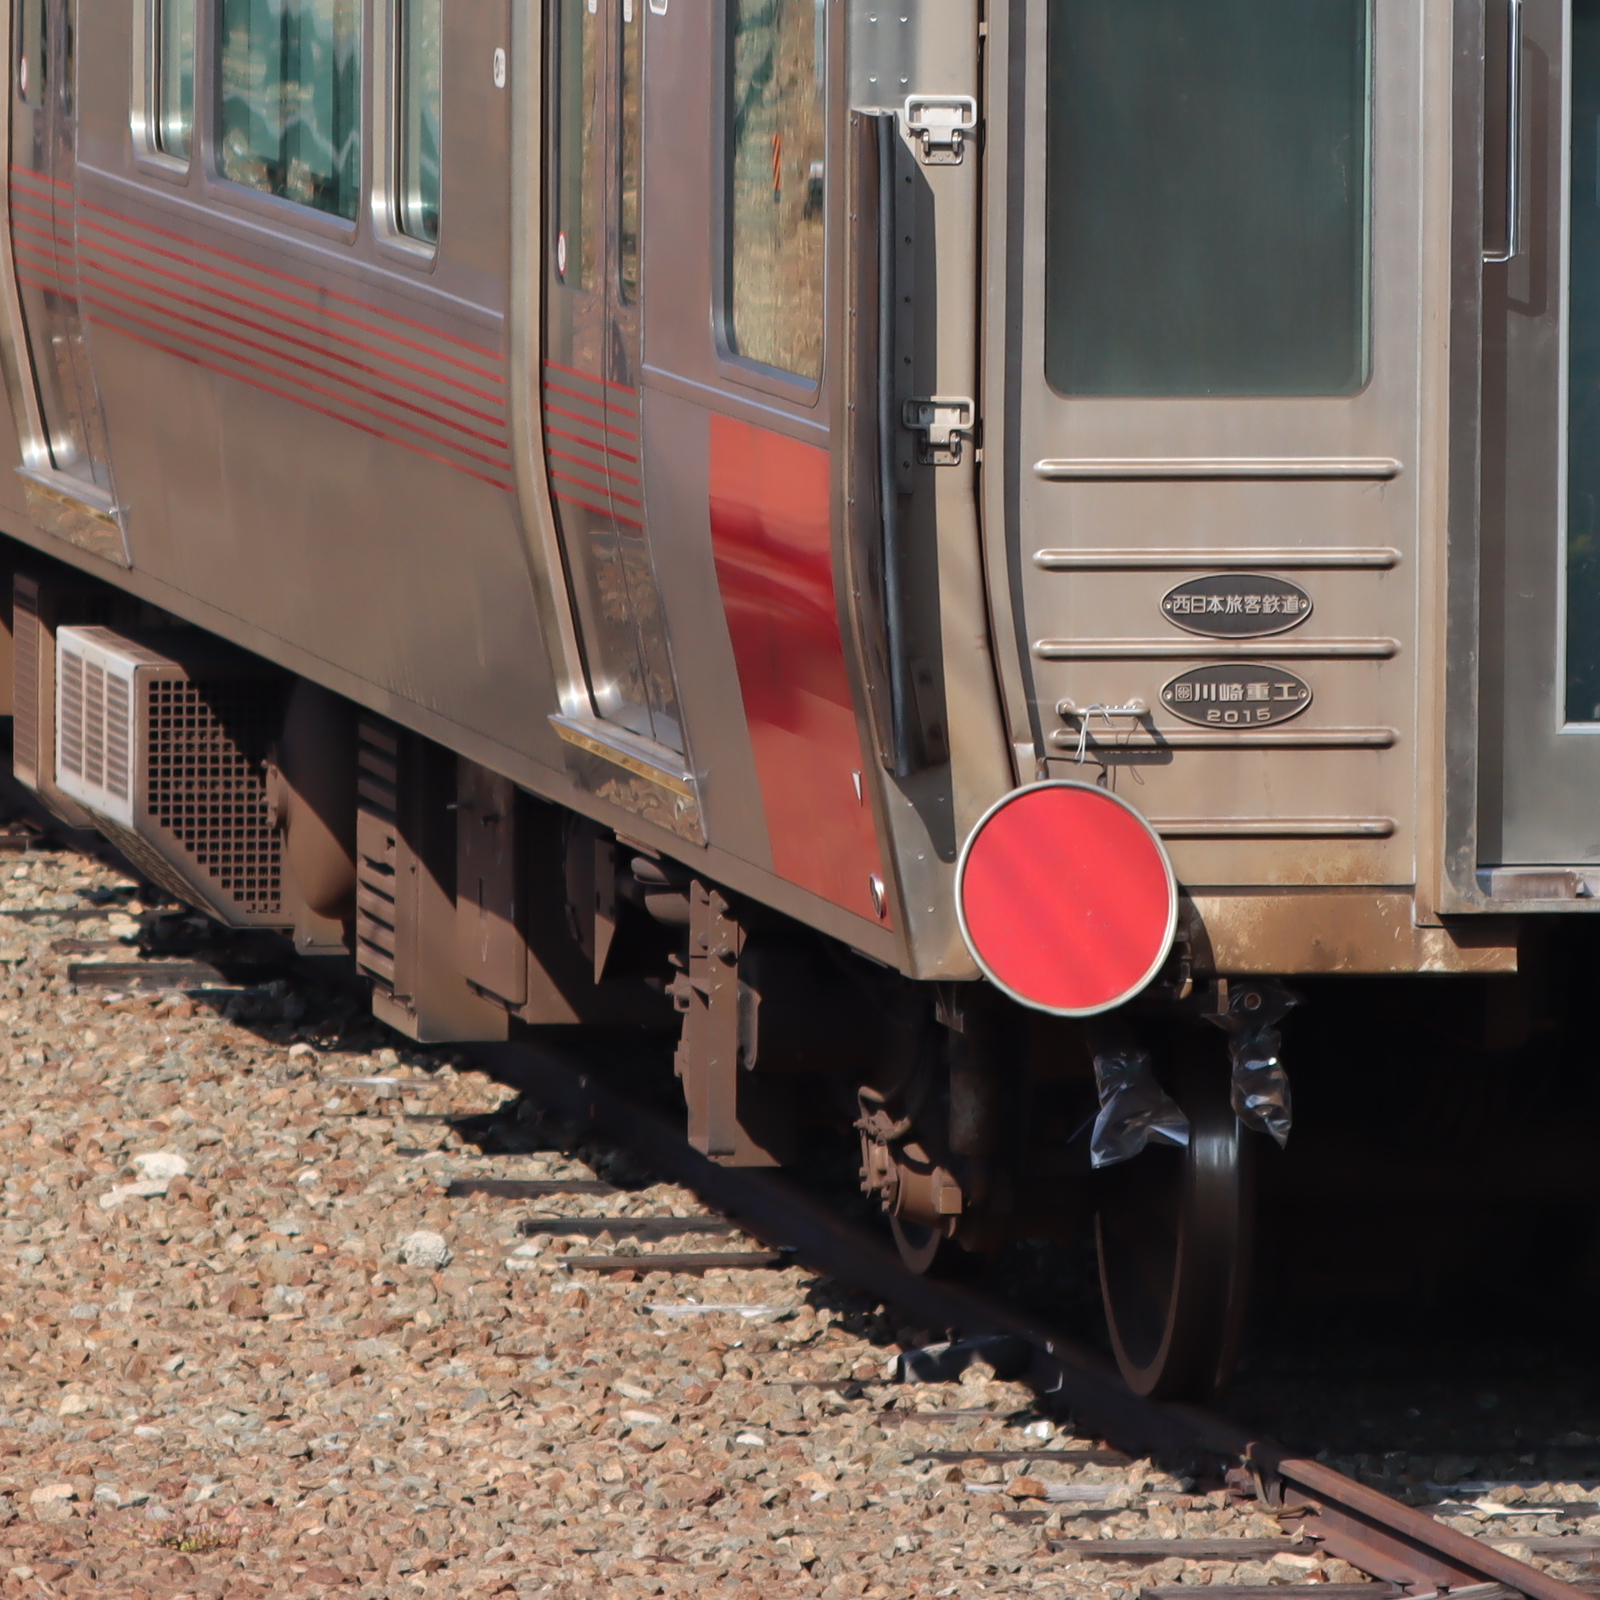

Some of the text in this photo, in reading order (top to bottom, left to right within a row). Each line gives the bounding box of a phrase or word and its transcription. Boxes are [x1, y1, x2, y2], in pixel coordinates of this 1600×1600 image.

[1193, 682, 1299, 702] 川崎重工
[1206, 707, 1271, 723] 2015
